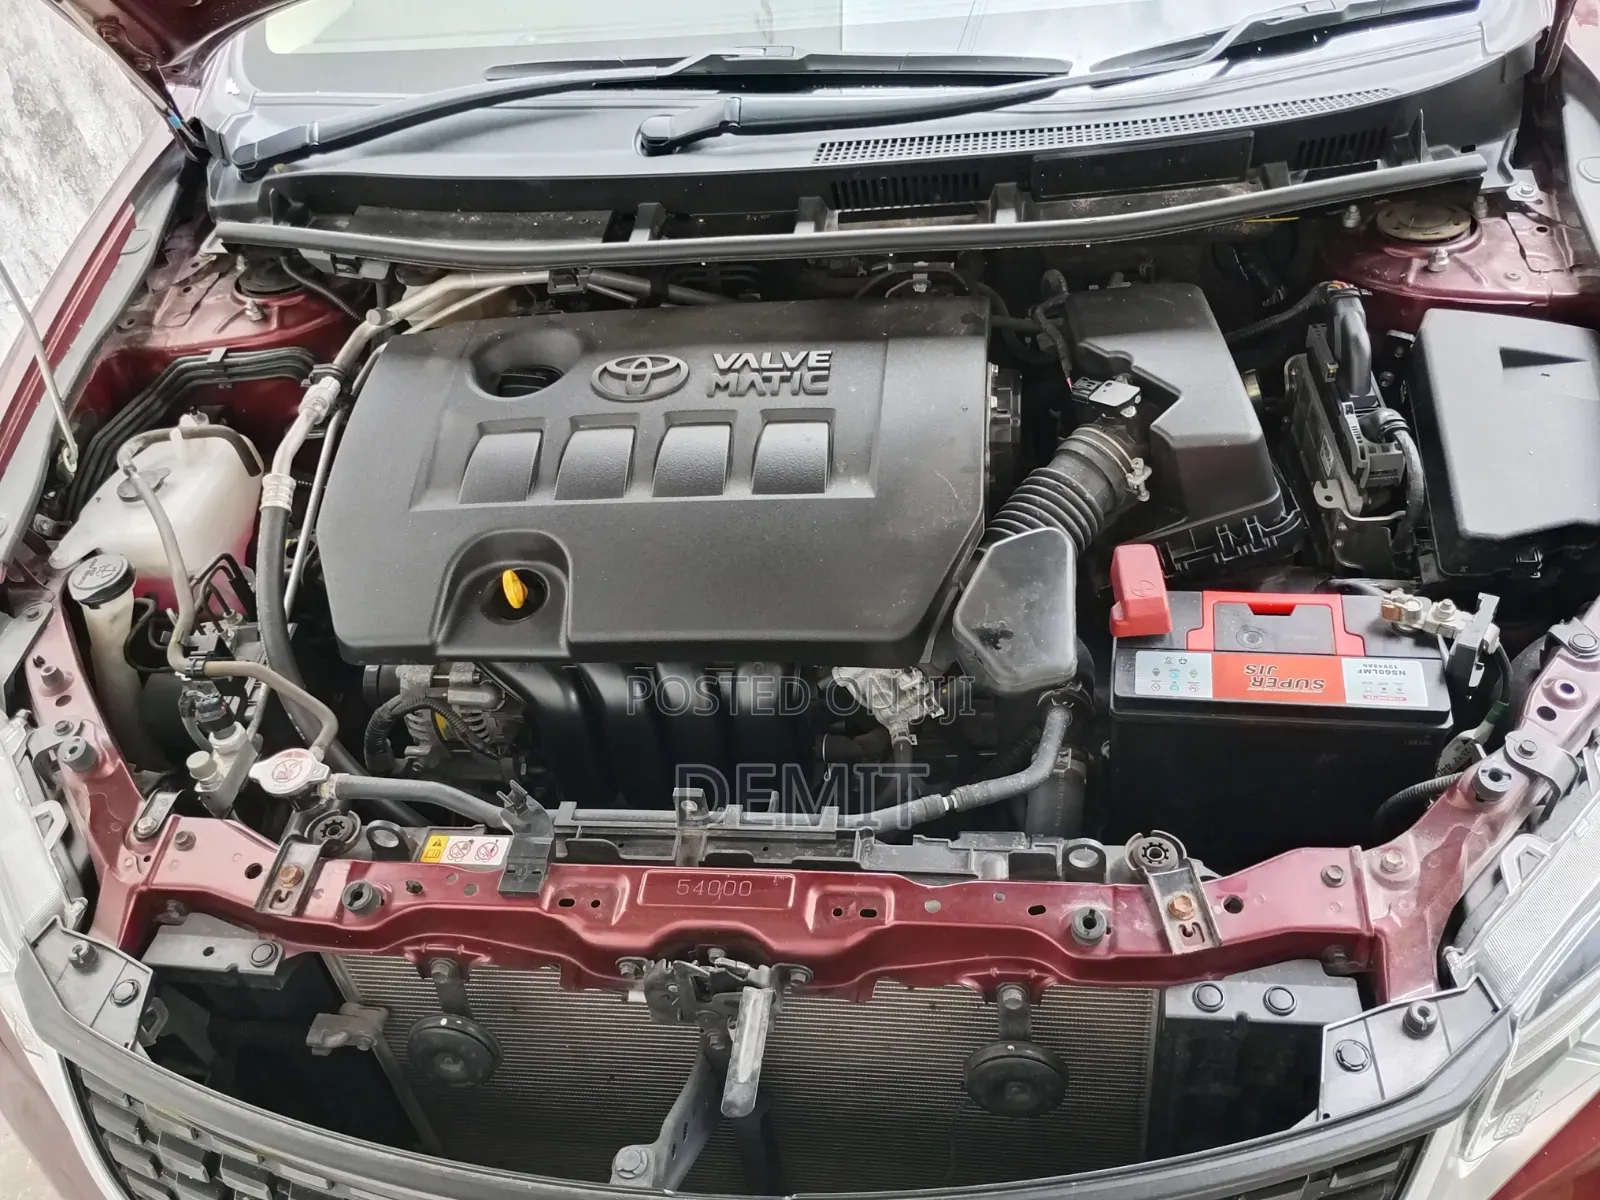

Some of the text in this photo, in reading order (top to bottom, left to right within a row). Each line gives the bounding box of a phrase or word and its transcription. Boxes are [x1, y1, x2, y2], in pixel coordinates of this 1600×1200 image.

[713, 350, 832, 371] VALVE
[706, 370, 829, 398] MATIC
[1243, 664, 1279, 676] JIS
[1250, 676, 1326, 690] SUPER
[676, 879, 753, 897] 54000
